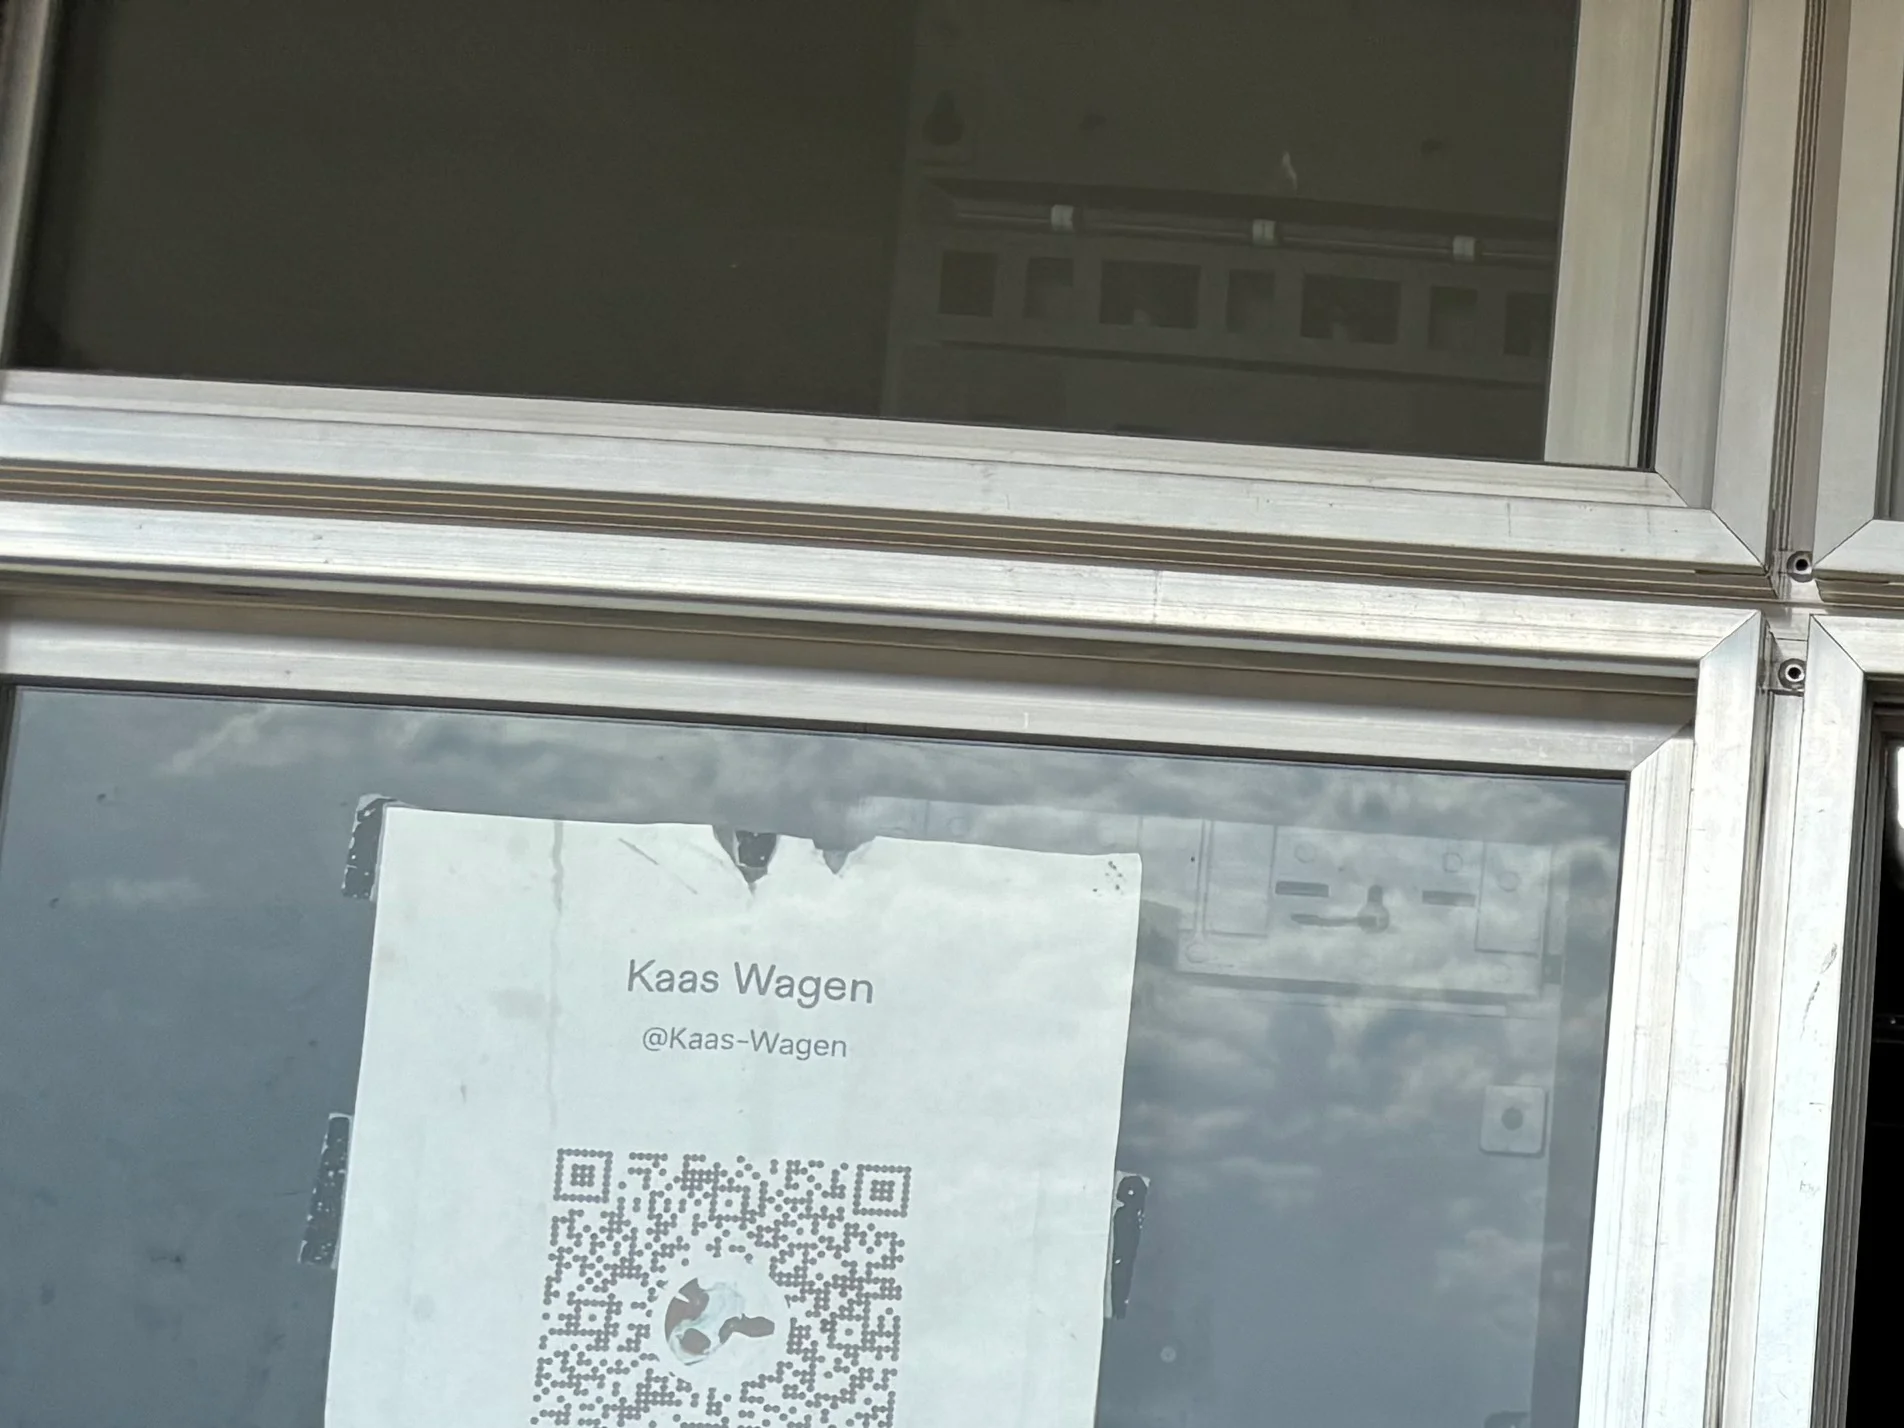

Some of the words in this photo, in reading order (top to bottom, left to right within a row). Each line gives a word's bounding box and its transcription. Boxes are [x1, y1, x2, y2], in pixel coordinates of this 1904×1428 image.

[628, 957, 720, 996] Kaas
[734, 961, 875, 1011] Wagen
[641, 1024, 848, 1063] @Kaas-Wagen
